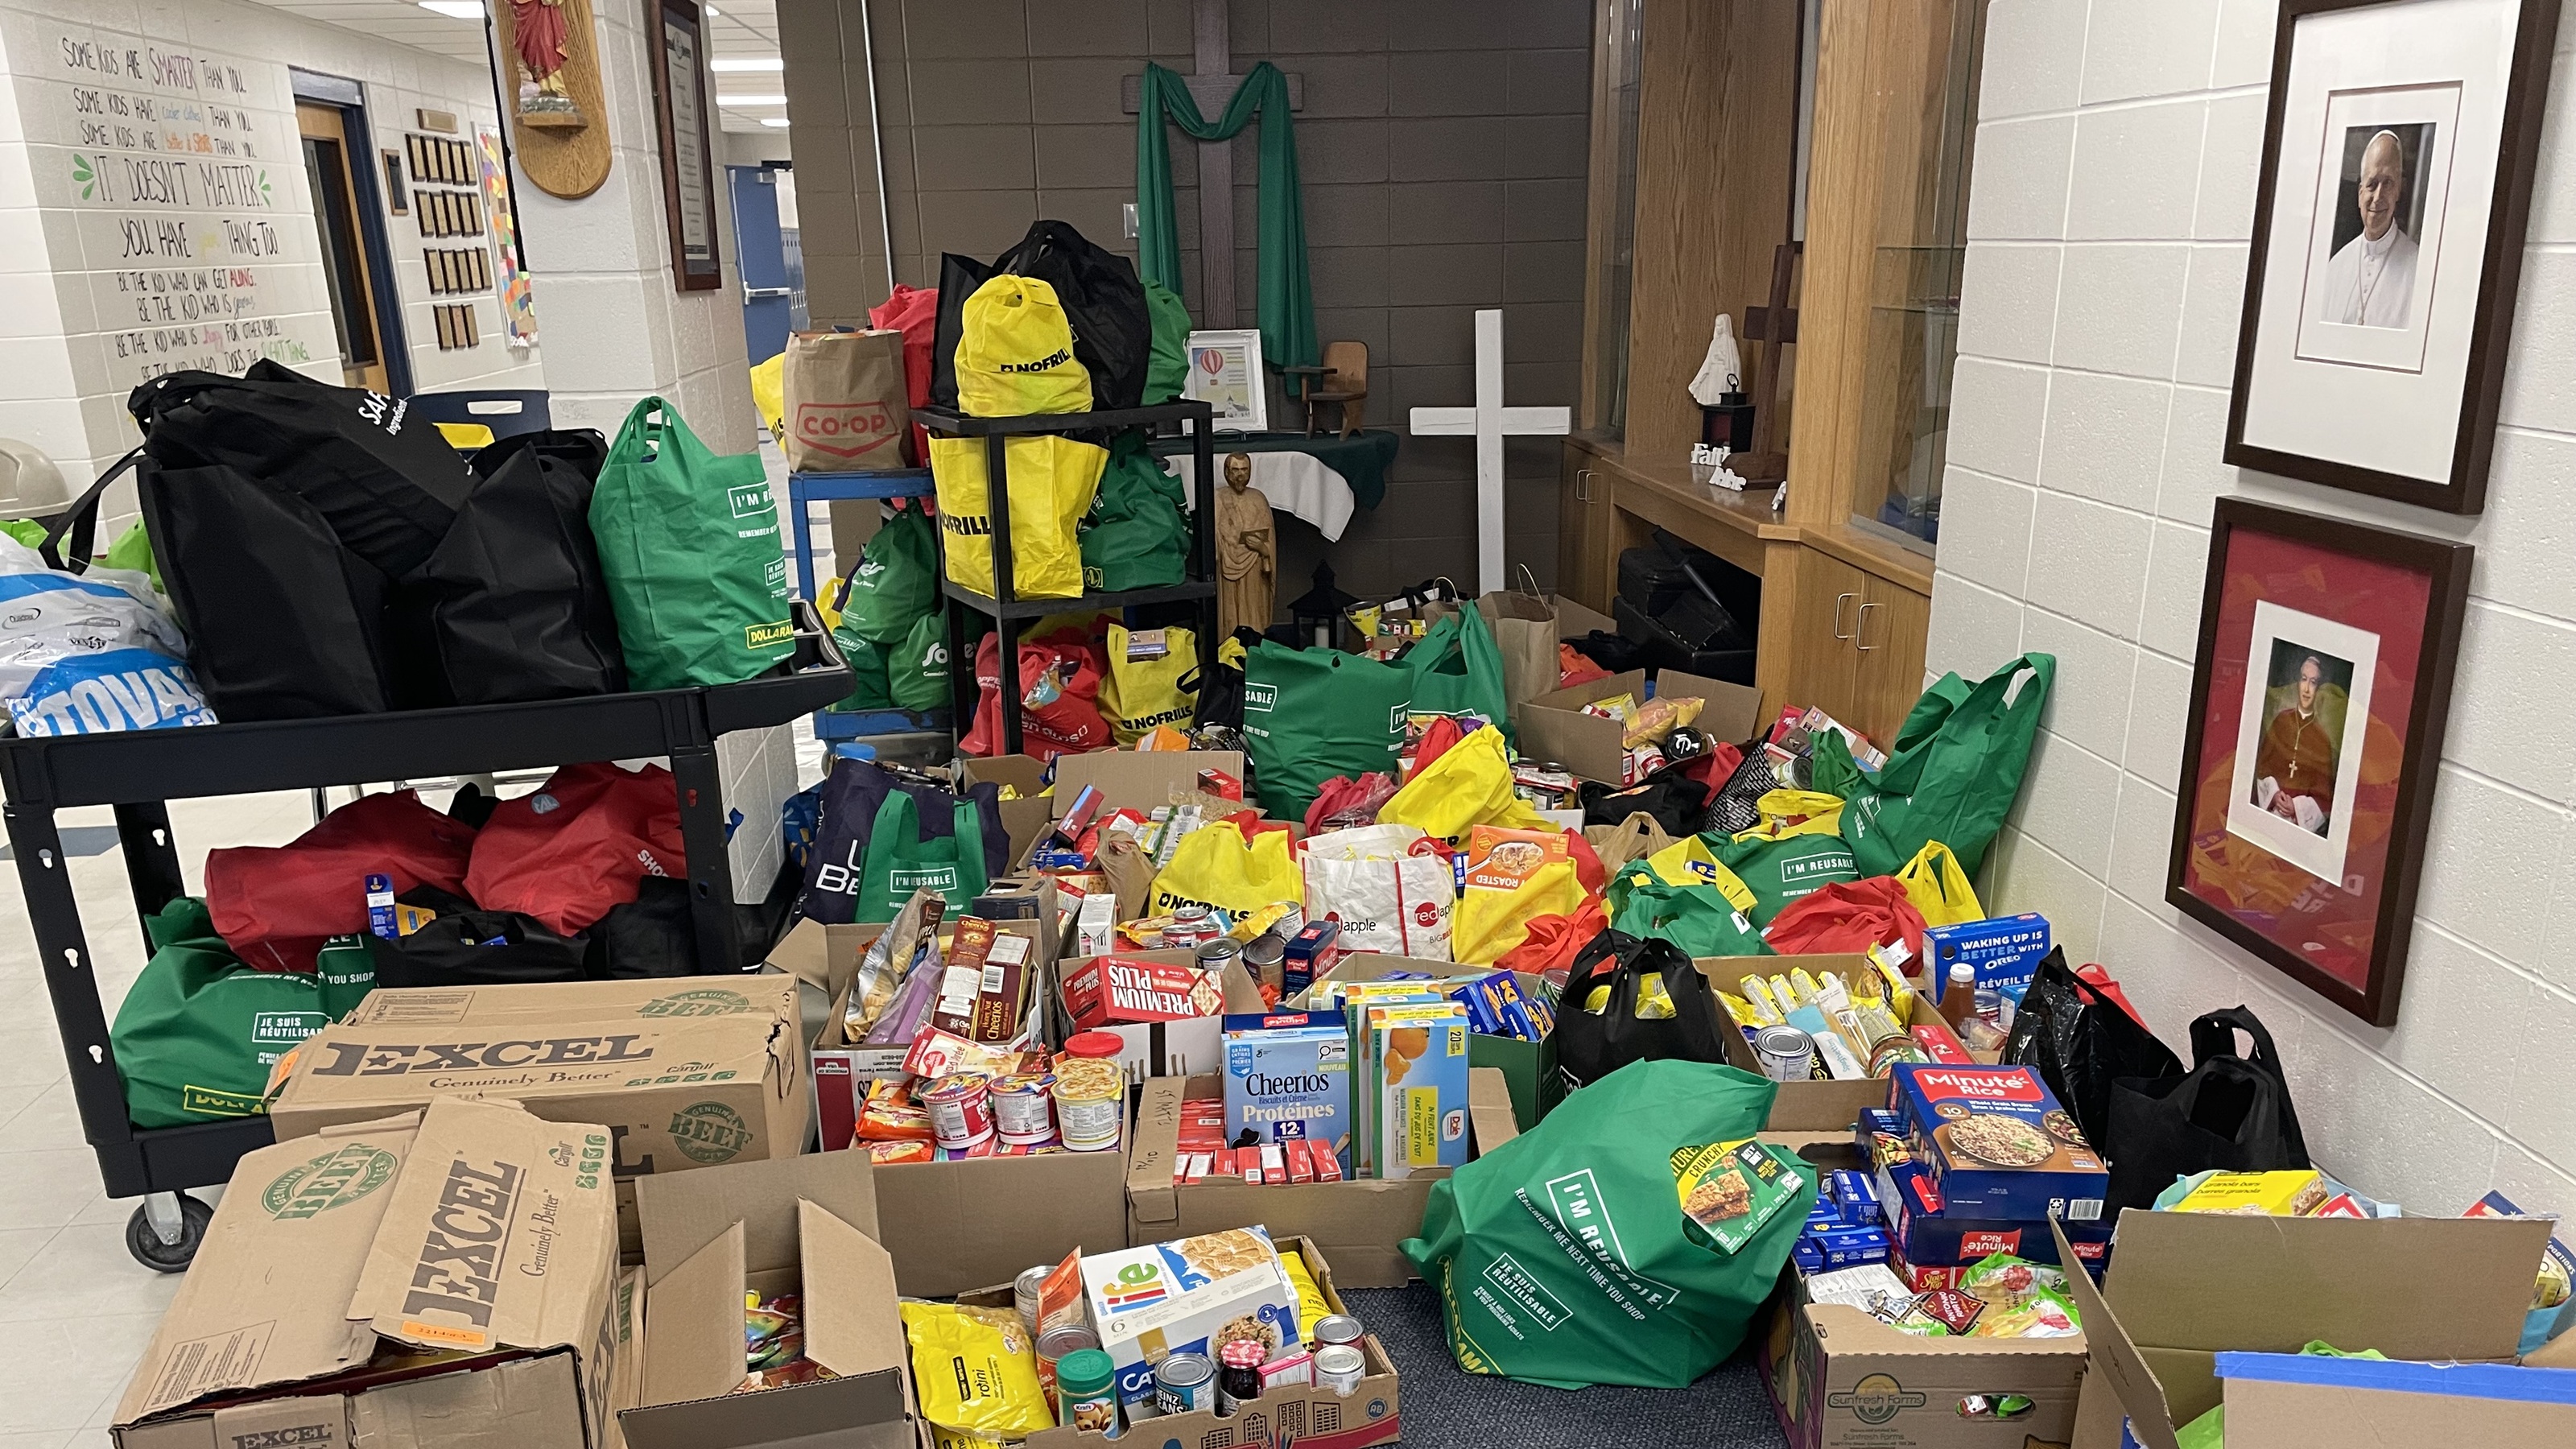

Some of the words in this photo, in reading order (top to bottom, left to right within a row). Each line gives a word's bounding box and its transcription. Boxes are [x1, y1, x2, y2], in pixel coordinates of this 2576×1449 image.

[62, 37, 95, 70] SOME
[97, 43, 119, 75] KIDS
[126, 50, 142, 80] ARE
[149, 47, 197, 90] SMARTER
[200, 59, 224, 90] THAN
[73, 88, 103, 114] SOME
[107, 93, 128, 116] KIDS
[134, 97, 156, 122] HAVE
[208, 106, 230, 129] THAN
[80, 121, 109, 145] SOME
[116, 126, 135, 147] KIDS
[143, 130, 157, 150] ARE
[215, 138, 235, 155] THAN
[95, 155, 114, 202] IT
[125, 157, 190, 205] DOESN'T
[119, 217, 155, 258] YOU
[155, 219, 192, 258] HAVE
[223, 220, 260, 257] THING
[116, 271, 129, 291] BE
[130, 271, 147, 291] THE
[151, 272, 166, 293] KID
[167, 272, 188, 291] WHO
[193, 271, 208, 291] CAN
[213, 269, 227, 288] GET
[136, 297, 151, 322] BE
[152, 295, 175, 321] THE
[180, 294, 200, 320] KID
[200, 294, 220, 315] WHO
[221, 293, 232, 313] IS
[114, 335, 129, 358] BE
[128, 332, 148, 354] THE
[153, 331, 167, 353] KID
[170, 329, 187, 348] WHO
[190, 328, 198, 345] IS
[225, 323, 241, 342] FOR
[243, 320, 262, 339] OTHER
[193, 356, 217, 375] WHO
[224, 349, 245, 373] DOES
[736, 493, 759, 508] I'M
[738, 528, 770, 539] REMEMBER
[1134, 705, 1194, 731] NOFRILLS
[1787, 864, 1804, 874] I'M
[1810, 859, 1853, 871] REUSABLE
[896, 877, 909, 886] I'M
[1476, 875, 1518, 887] ROASTED
[1783, 889, 1811, 897] REMEMBER
[1414, 903, 1439, 922] red
[1344, 919, 1376, 935] apple
[1961, 936, 2009, 951] WAKING
[2013, 933, 2029, 943] UP
[2032, 931, 2042, 940] IS
[1961, 945, 2016, 961] BETTER
[2018, 943, 2043, 953] WITH
[1984, 955, 2021, 971] OREO
[328, 975, 348, 985] YOU
[350, 972, 375, 983] SHOP
[1073, 968, 1098, 991] PREMIUM
[1085, 976, 1100, 992] PLUS
[1108, 964, 1153, 990] PLUS
[1979, 975, 2021, 989] RÉVEIL
[1113, 987, 1195, 1016] PREMIUM
[260, 1018, 273, 1027] JE
[277, 1018, 301, 1027] SUIS
[986, 1001, 1003, 1040] Cheerios
[1451, 1030, 1462, 1042] 20
[312, 1034, 654, 1076] EXCEL
[667, 1061, 713, 1074] Cargill
[1319, 1063, 1346, 1072] NOUVEAU
[429, 1074, 539, 1089] Genuinely
[547, 1071, 613, 1084] Better
[1246, 1069, 1329, 1096] Cheerios
[1924, 1072, 2024, 1088] Minute
[1259, 1096, 1282, 1104] Biscuits
[1289, 1093, 1307, 1102] Crème
[1960, 1086, 2005, 1096] Rice
[1243, 1102, 1335, 1122] Protéines
[1414, 1096, 1422, 1110] DANS
[1945, 1107, 1962, 1116] 10
[1414, 1112, 1422, 1120] DU
[667, 1112, 753, 1151] BEEF
[1414, 1121, 1422, 1131] JUS
[1451, 1116, 1461, 1136] Dole
[551, 1141, 573, 1167] Cargill
[1414, 1141, 1422, 1157] FRUIT
[1689, 1144, 1724, 1179] CRUNCHY
[272, 1143, 382, 1221] BEEF
[2205, 1181, 2239, 1189] granola
[531, 1194, 559, 1226] Better
[402, 1159, 518, 1327] EXCEL
[1563, 1183, 1591, 1219] I'M
[1579, 1224, 1662, 1305] REUSABLE
[1966, 1241, 2015, 1253] Minute
[1980, 1234, 2002, 1242] Rice
[520, 1224, 561, 1277] Genuinely
[1514, 1187, 1556, 1232] REMEMBER
[1553, 1231, 1570, 1247] ME
[1566, 1245, 1589, 1267] NEXT
[1586, 1264, 1609, 1288] TIME
[1606, 1285, 1624, 1302] YOU
[1621, 1301, 1645, 1321] SHOP
[2074, 1245, 2103, 1254] Minute
[2548, 1244, 2575, 1275] PORTIONS
[1500, 1262, 1513, 1274] JE
[1513, 1273, 1536, 1294] SUIS
[1919, 1272, 1946, 1289] Stove
[1930, 1281, 1942, 1291] Top
[1492, 1268, 1556, 1323] RÉUTILISABLE
[1940, 1291, 1956, 1321] ANTONIO
[1948, 1294, 1965, 1318] AMATO
[1111, 1319, 1125, 1333] 6
[1831, 1395, 1886, 1406] Sunfresh
[1888, 1395, 1923, 1404] Farms
[232, 1423, 332, 1449] EXCEL
[1843, 1433, 1880, 1441] Sunfresh
[1881, 1433, 1905, 1442] Farms
